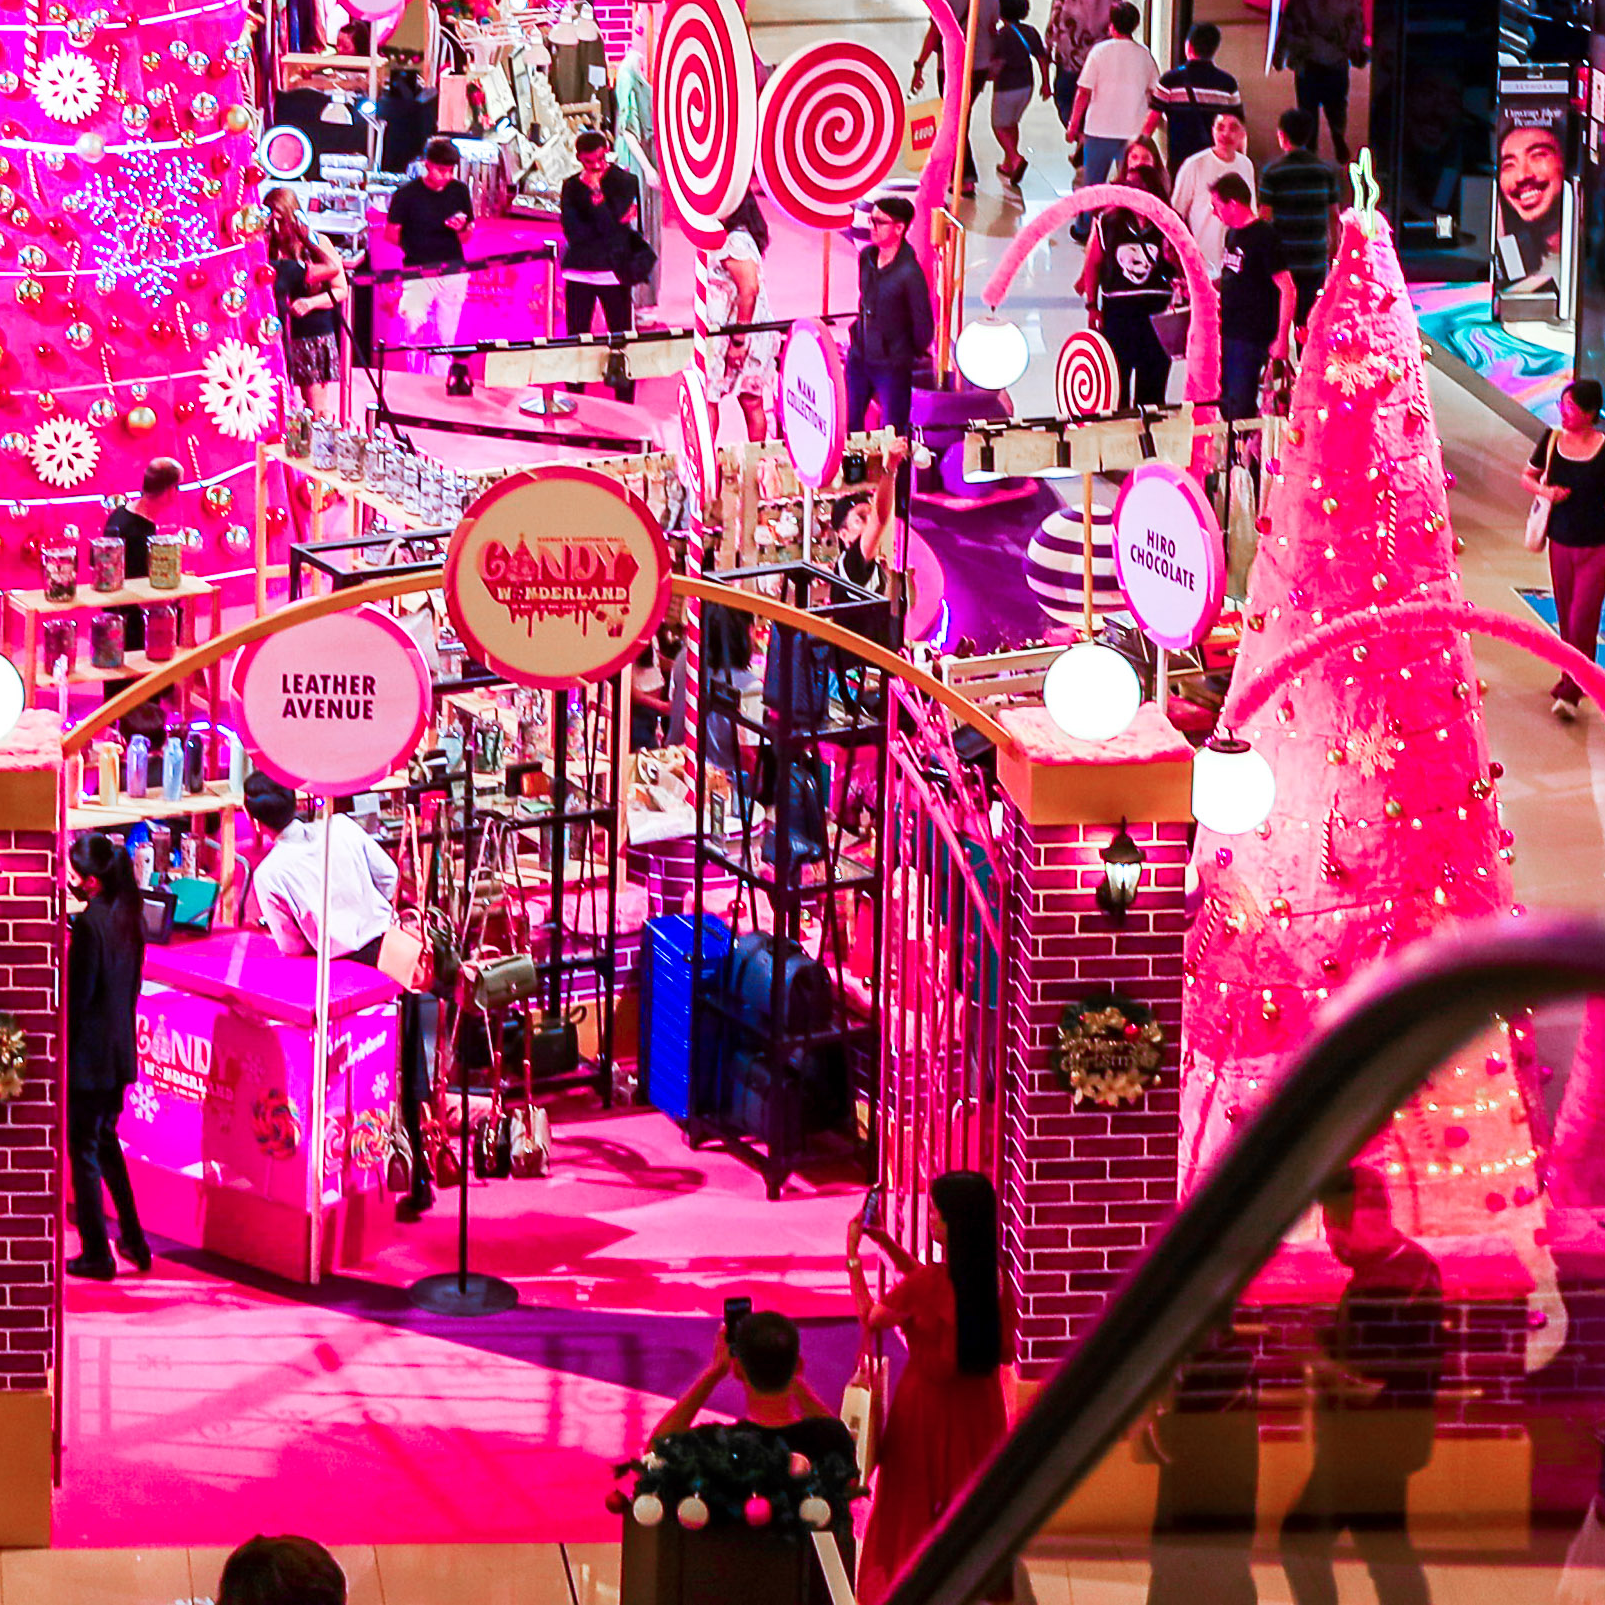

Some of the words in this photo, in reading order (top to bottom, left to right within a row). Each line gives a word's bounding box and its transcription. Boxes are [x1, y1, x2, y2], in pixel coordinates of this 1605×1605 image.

[1147, 528, 1176, 559] HIRO
[1130, 543, 1196, 592] CHOCOLATE
[281, 673, 377, 696] LEATHER
[281, 697, 374, 720] AVENUE
